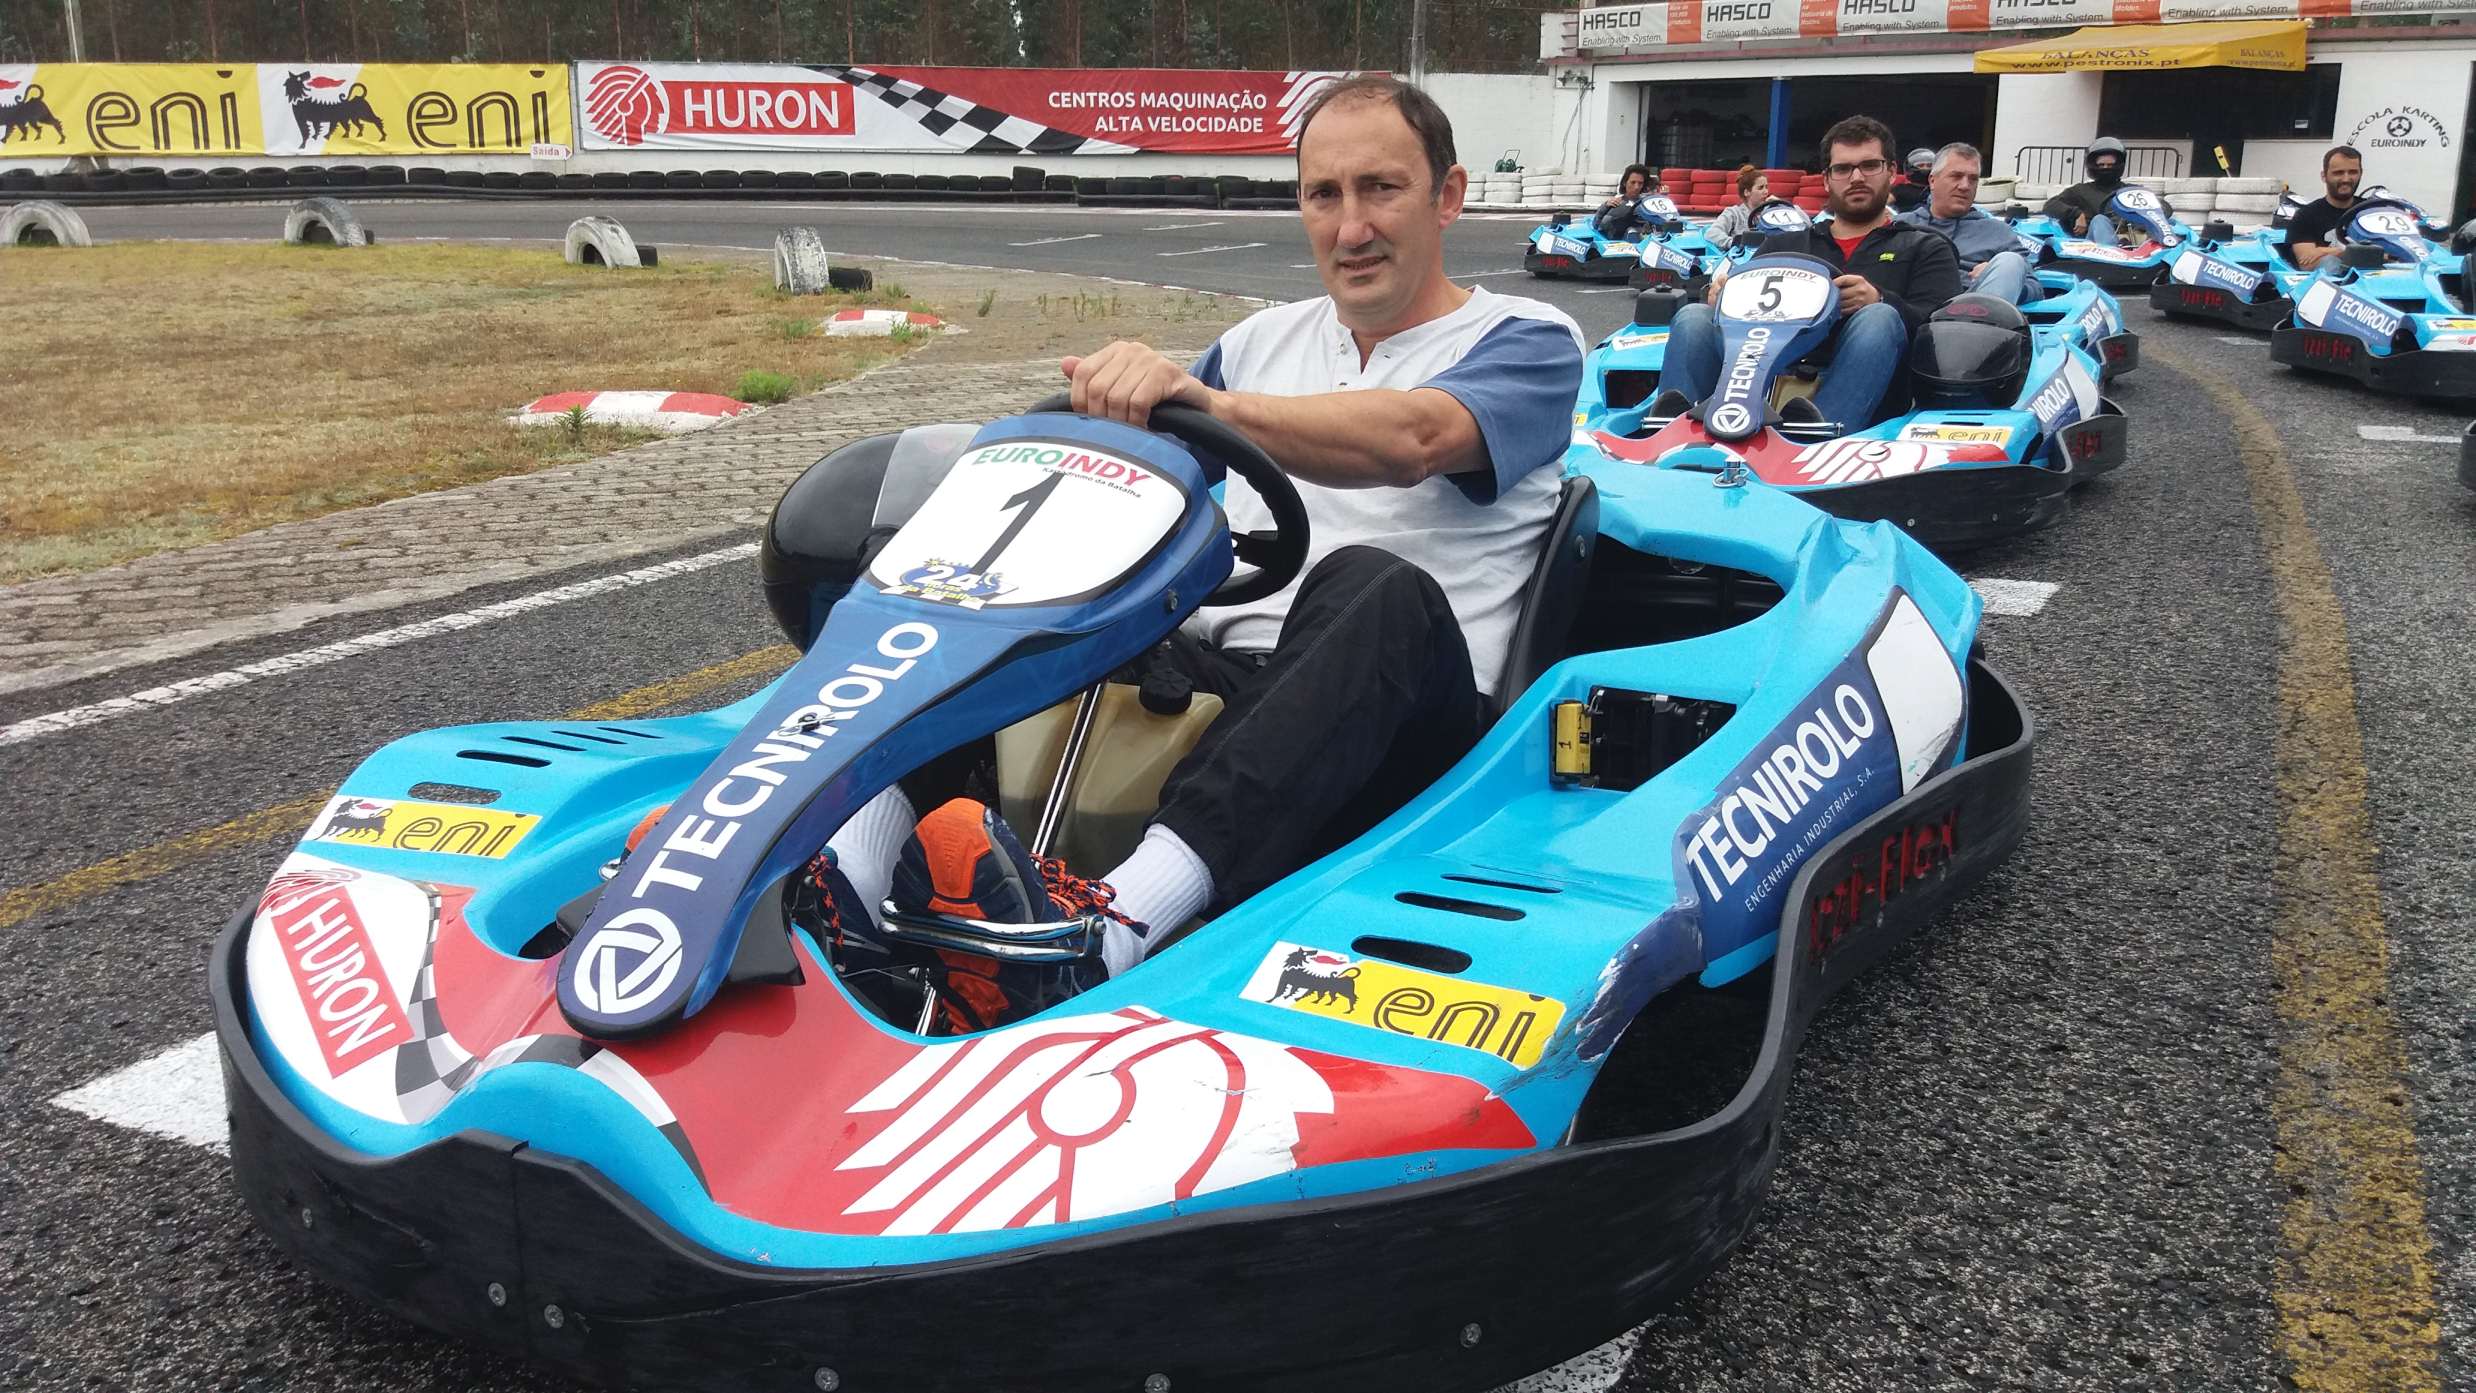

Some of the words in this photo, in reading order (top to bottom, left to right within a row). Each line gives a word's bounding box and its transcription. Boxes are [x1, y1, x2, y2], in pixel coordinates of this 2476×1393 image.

[1583, 11, 1641, 30] HASCO
[1706, 2, 1771, 23] HASCO
[1996, 15, 2039, 25] Enabling
[2042, 14, 2062, 23] with
[2168, 8, 2216, 18] Enabling
[2220, 6, 2241, 16] with
[1706, 29, 1740, 39] Enabling
[1843, 22, 1881, 32] Enabling
[1883, 20, 1902, 30] with
[1582, 35, 1614, 47] Enabling
[86, 70, 241, 151] eni
[406, 70, 549, 149] eni
[684, 87, 839, 130] HURON
[1048, 91, 1136, 109] CENTROS
[1140, 89, 1267, 113] MAQUINAÇÃO
[1095, 116, 1144, 132] ALTA
[1147, 116, 1264, 133] VELOCIDADE
[2346, 107, 2393, 147] ESCOLA
[2402, 105, 2450, 148] KARTING
[2370, 138, 2428, 148] EUROINDY
[1651, 199, 1668, 213] 16
[2127, 192, 2149, 207] 26
[1771, 211, 1793, 225] 11
[2379, 215, 2411, 232] 29
[1740, 269, 1818, 280] EUROINDY
[2203, 260, 2255, 290] TECNIROLO
[1758, 275, 1784, 312] 5
[2334, 293, 2398, 337] TECNIROLO
[1723, 327, 1771, 402] TECNIROLO
[1948, 428, 2004, 443] eni
[972, 447, 1153, 487] EUROINDY
[1107, 481, 1142, 498] Batalha
[970, 470, 1066, 577] 1
[912, 563, 981, 591] 24
[631, 621, 940, 899] TECNIROLO
[1684, 683, 1875, 904] TECNIROLO
[392, 812, 527, 858] eni
[1744, 842, 1805, 913] ENGENHARIA
[1803, 786, 1859, 847] INDUSTRIAL,
[1857, 766, 1876, 786] S.A.
[287, 897, 397, 1059] HURON
[1373, 986, 1546, 1065] eni
